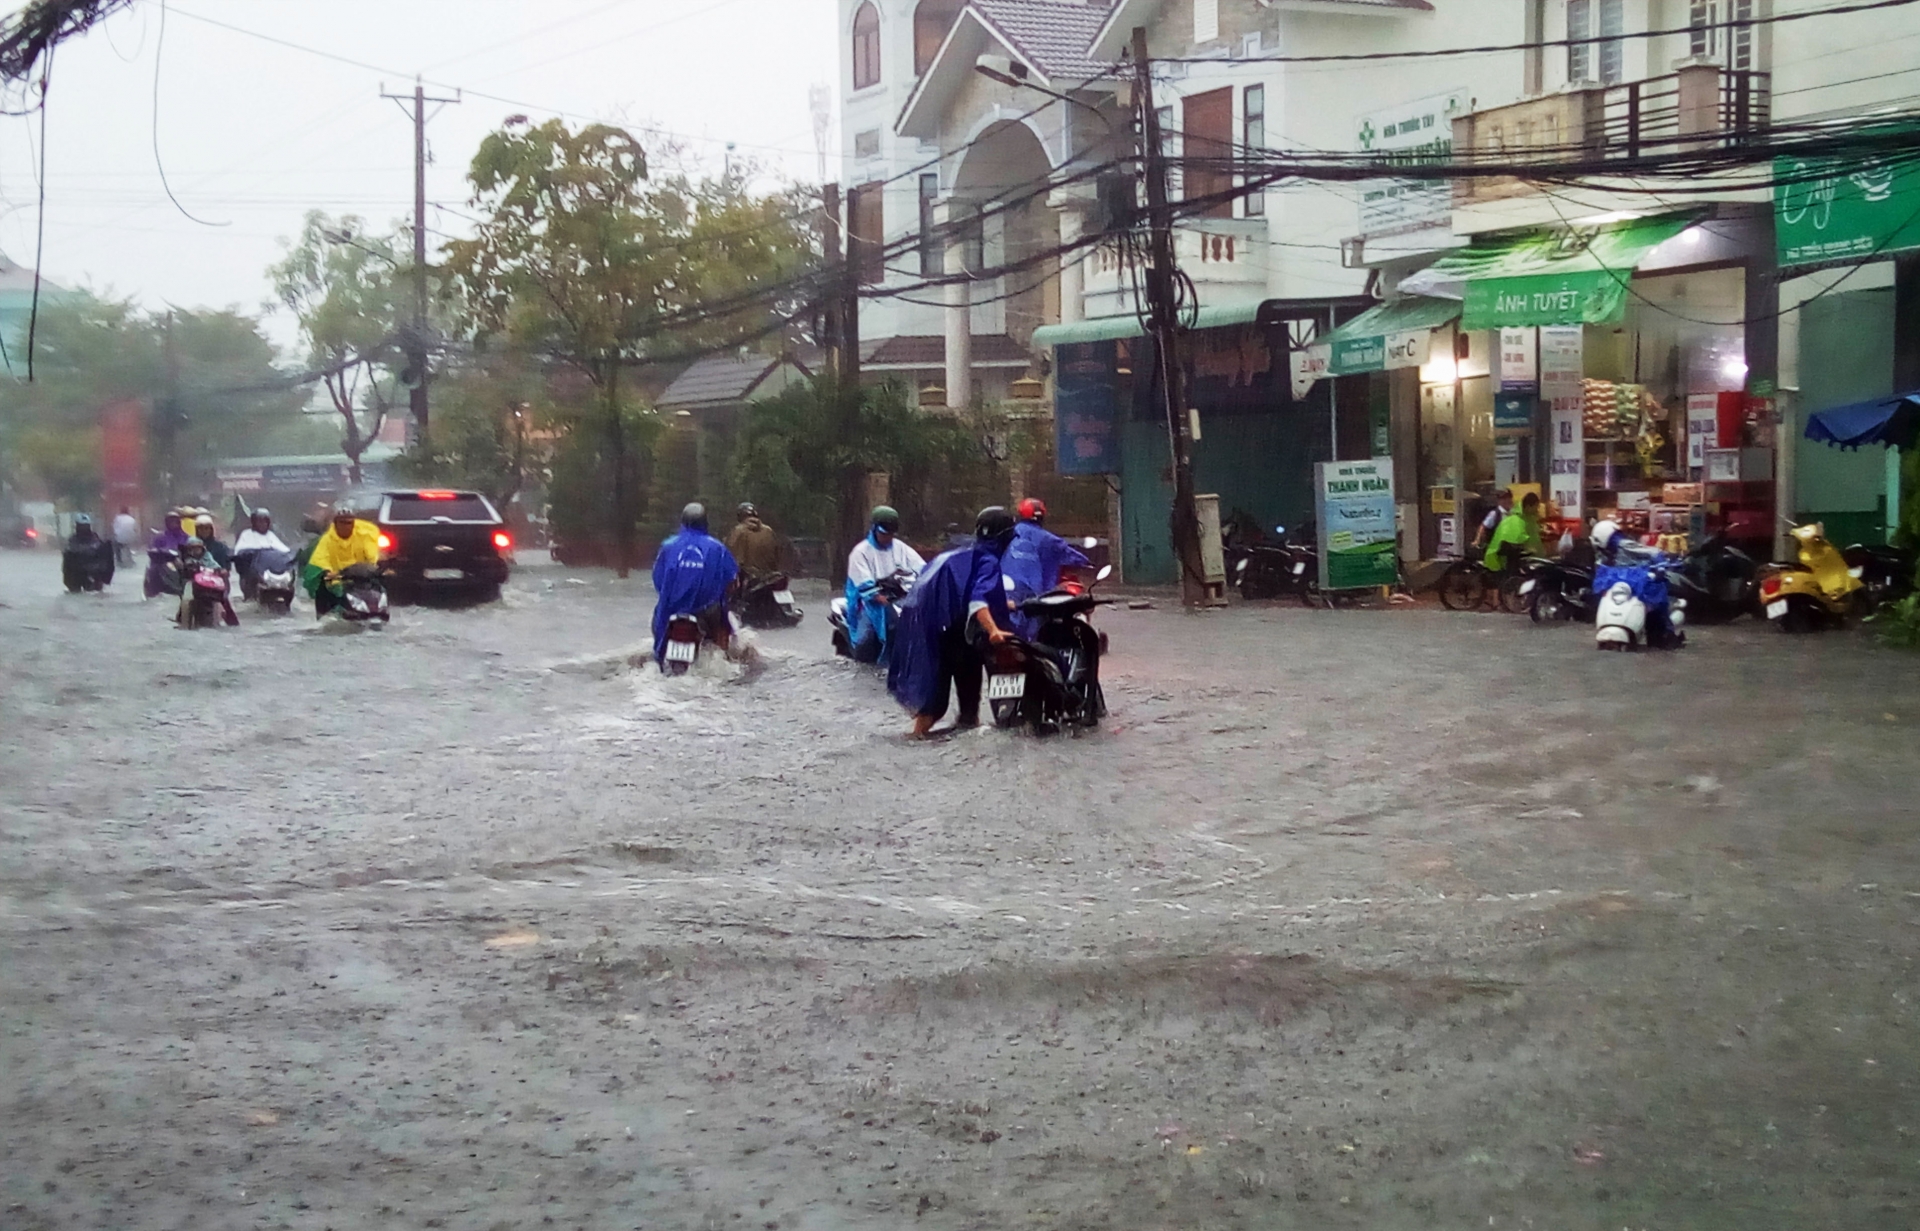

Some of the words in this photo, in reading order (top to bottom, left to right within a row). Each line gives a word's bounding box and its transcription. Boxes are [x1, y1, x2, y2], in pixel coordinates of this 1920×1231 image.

[1495, 290, 1527, 313] ÁNH
[1533, 282, 1579, 310] TUYẾT
[1327, 480, 1360, 493] THANH
[1361, 476, 1390, 492] NGÂN
